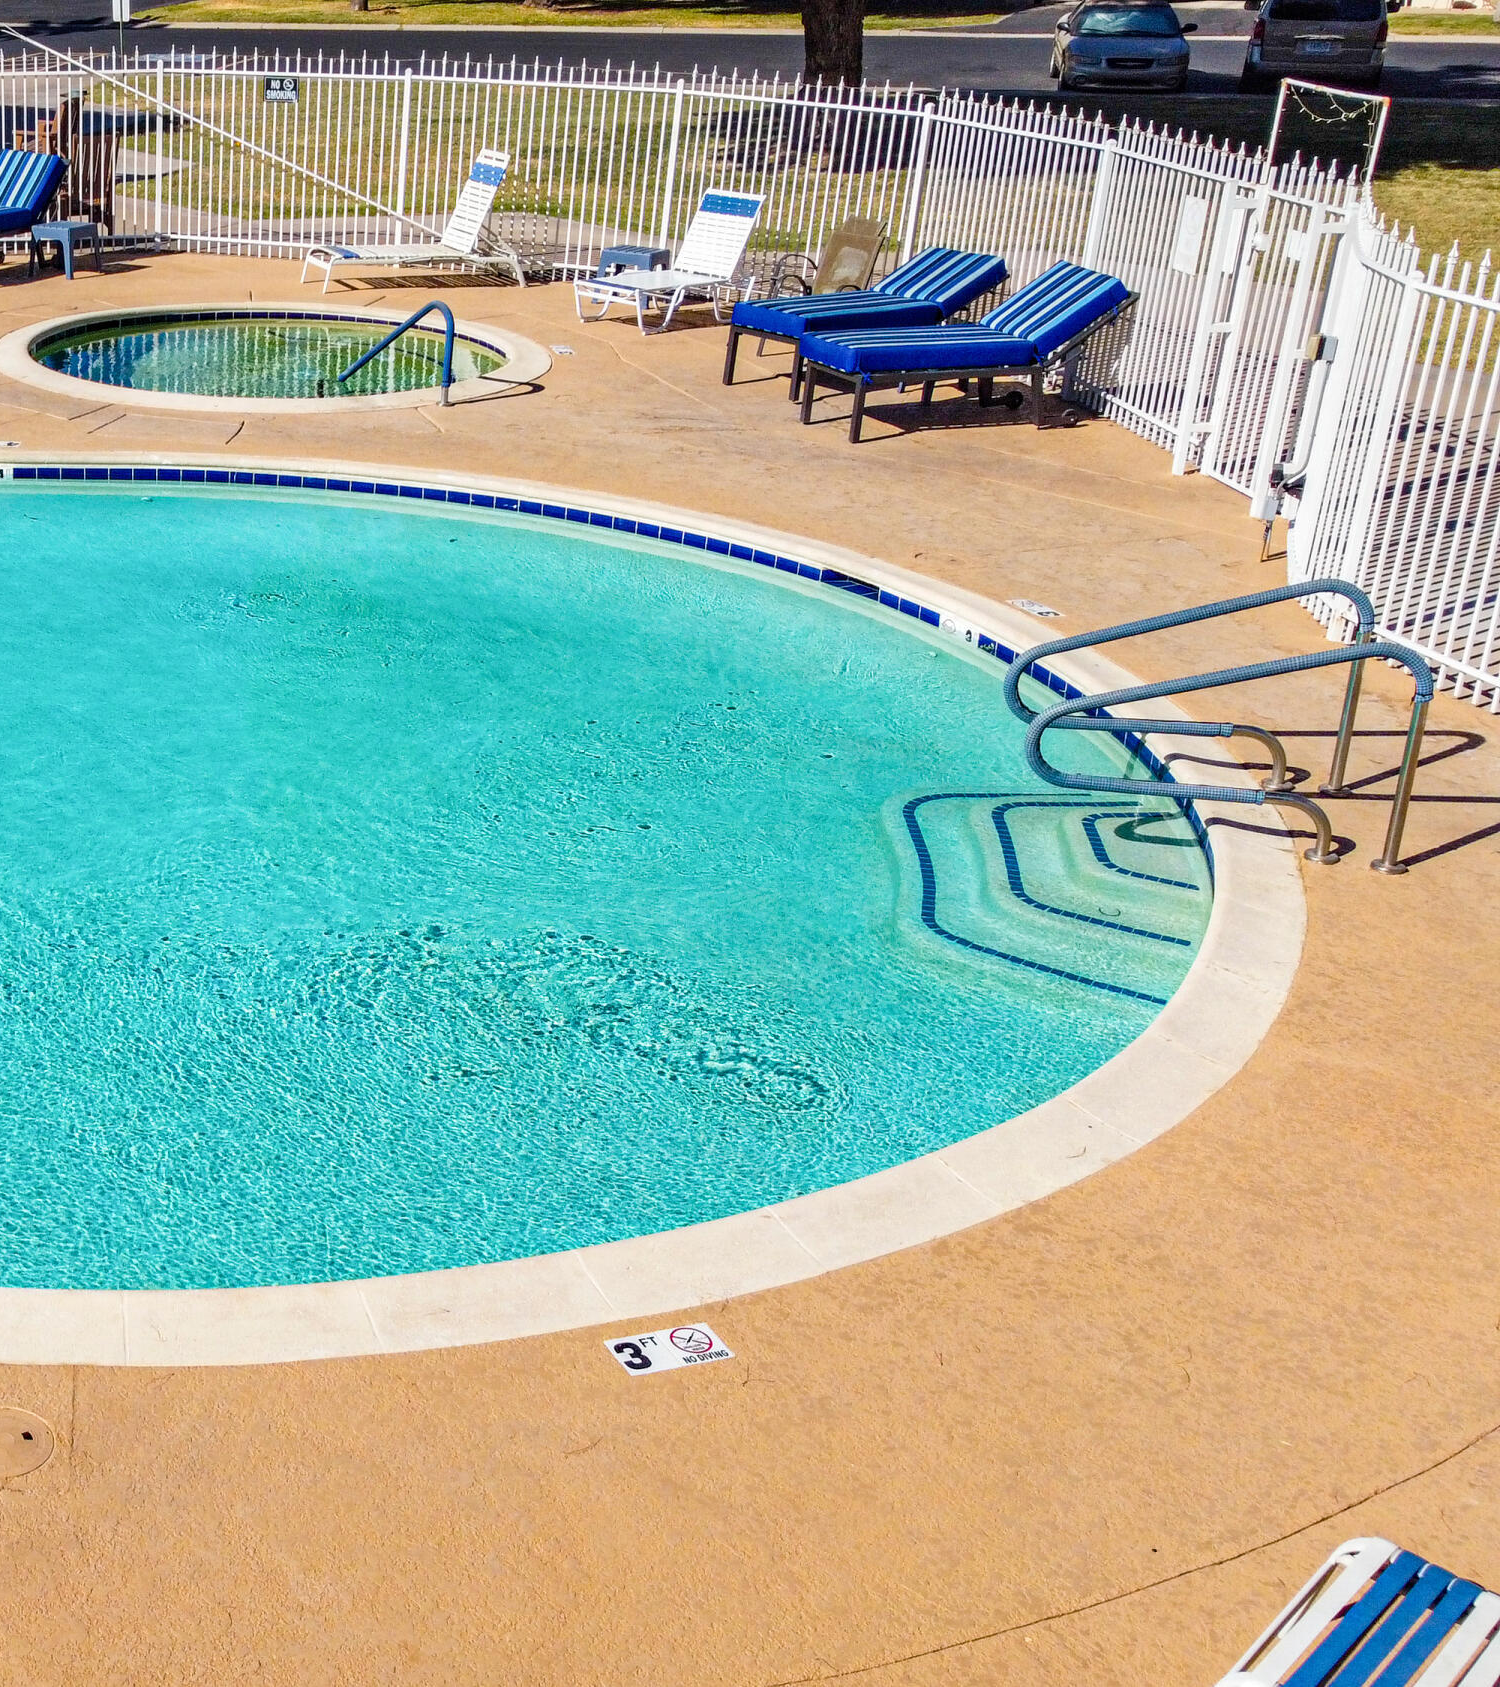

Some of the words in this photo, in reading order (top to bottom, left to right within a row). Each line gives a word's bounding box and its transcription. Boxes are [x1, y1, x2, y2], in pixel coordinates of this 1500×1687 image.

[270, 79, 281, 90] NO
[266, 89, 296, 100] SMOKING
[613, 1342, 652, 1370] 3
[639, 1336, 658, 1348] FT
[682, 1355, 698, 1365] NO
[697, 1349, 729, 1362] DIVING
